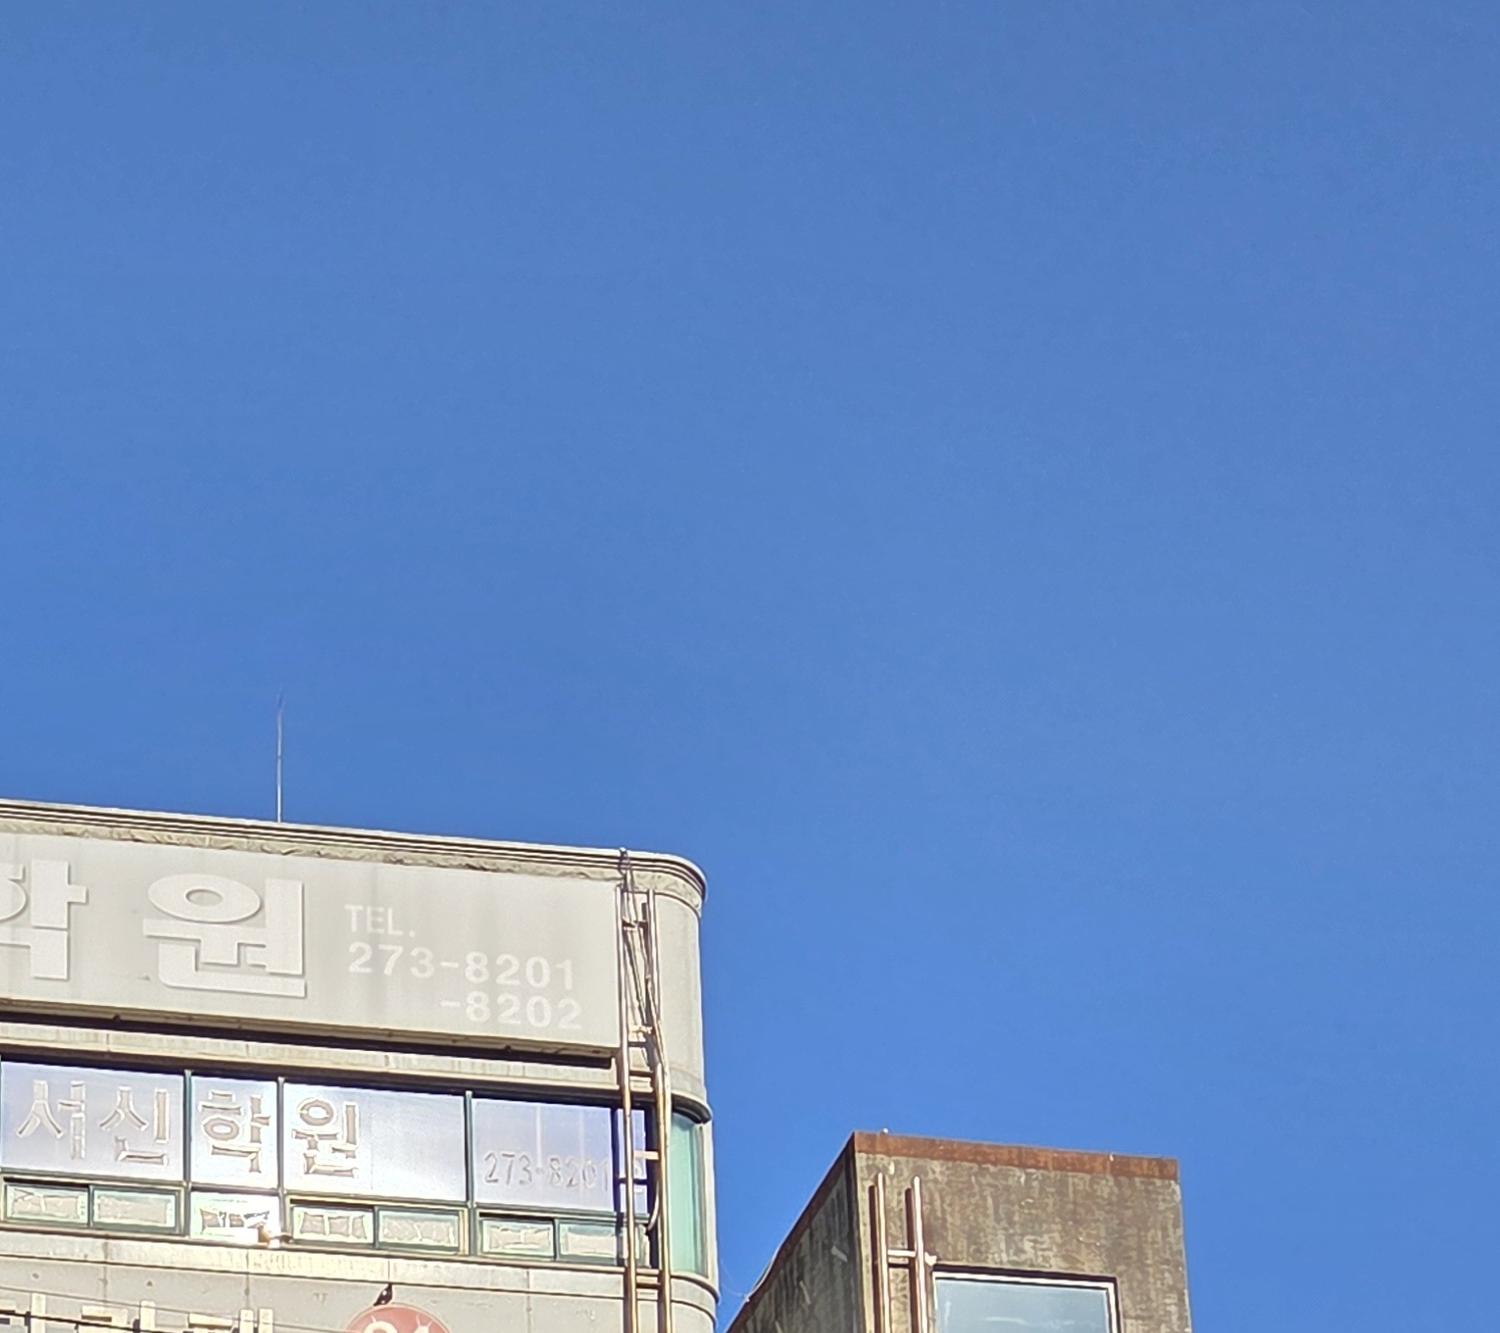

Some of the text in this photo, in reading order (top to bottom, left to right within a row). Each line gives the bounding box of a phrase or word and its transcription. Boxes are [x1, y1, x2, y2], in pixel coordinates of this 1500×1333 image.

[344, 903, 416, 939] TEL.
[348, 941, 576, 991] 273-8201
[439, 992, 584, 1030] -8202
[16, 1079, 361, 1180] 서신학원
